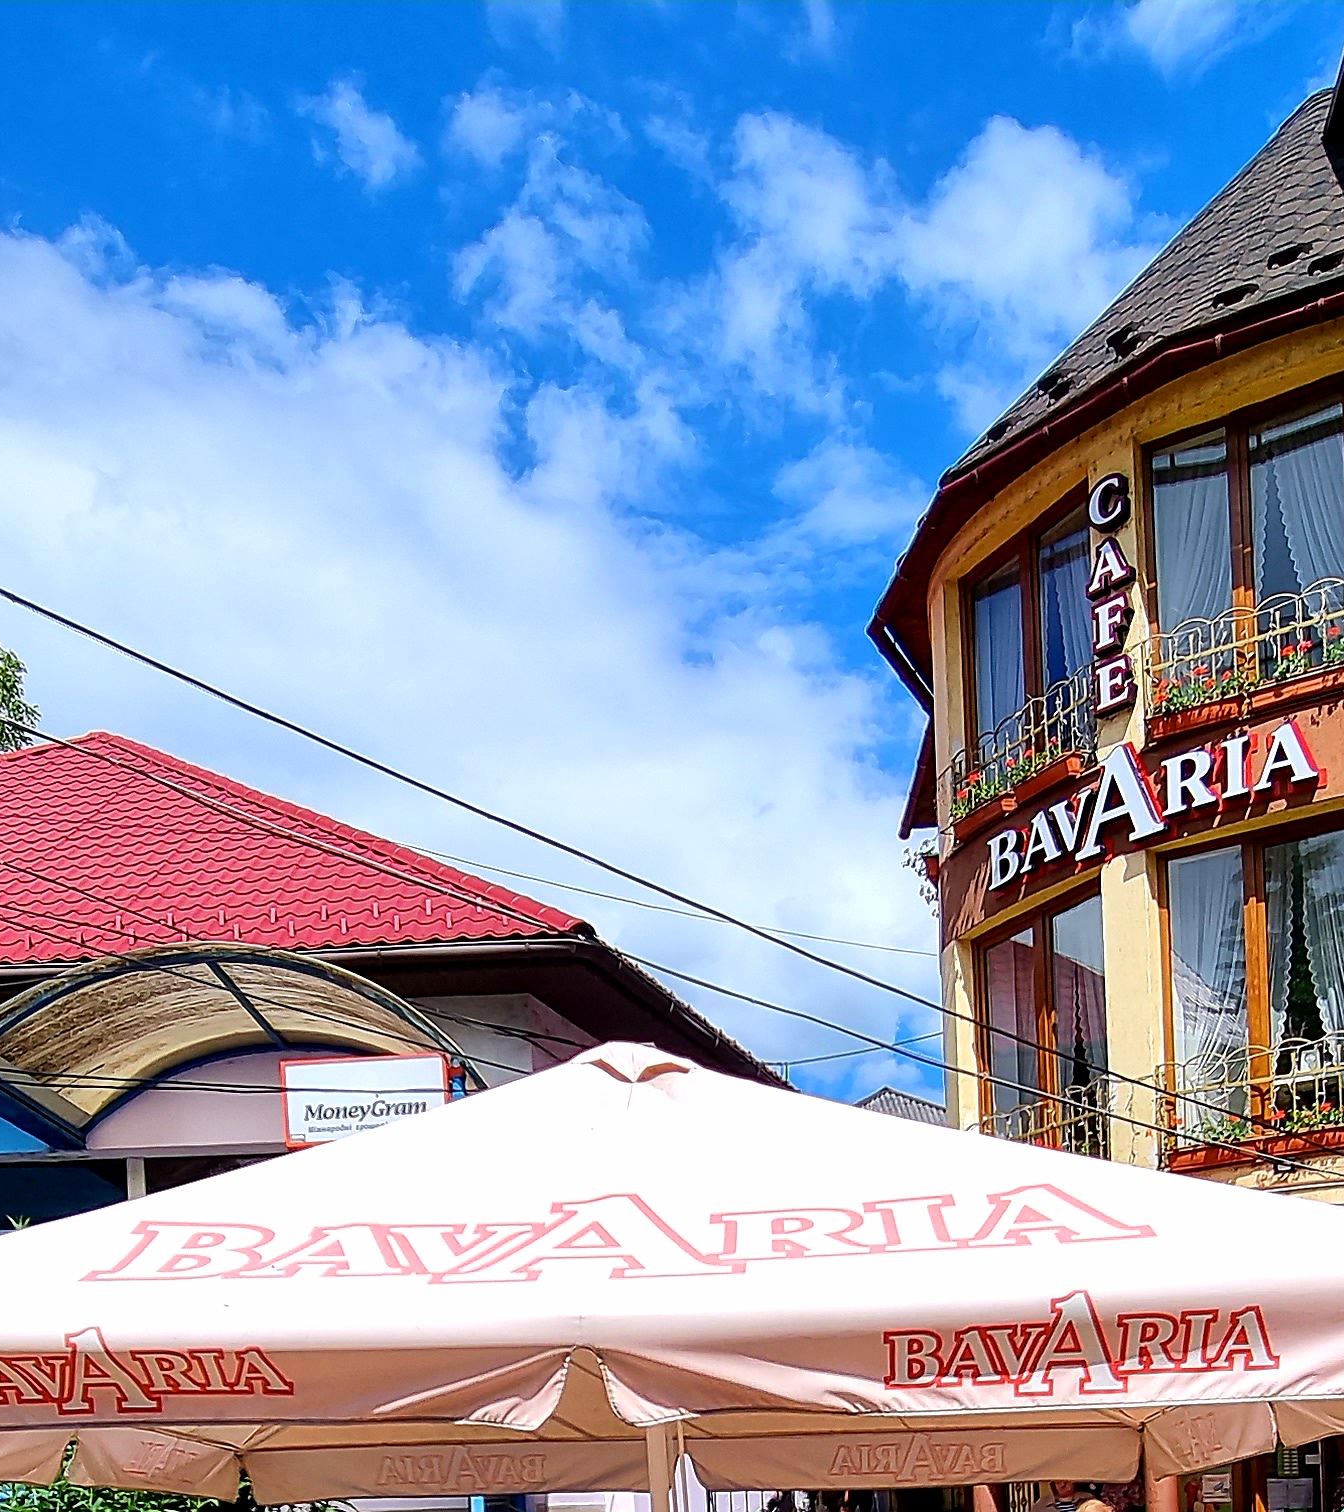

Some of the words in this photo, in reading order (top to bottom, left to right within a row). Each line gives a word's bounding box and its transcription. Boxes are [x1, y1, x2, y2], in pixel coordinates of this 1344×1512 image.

[1086, 473, 1134, 715] CAFE
[987, 719, 1325, 893] BAVARIA
[304, 1099, 427, 1122] MoneyGram
[80, 1184, 1156, 1284] BAVARIA
[884, 1290, 1280, 1396] BAVARIA
